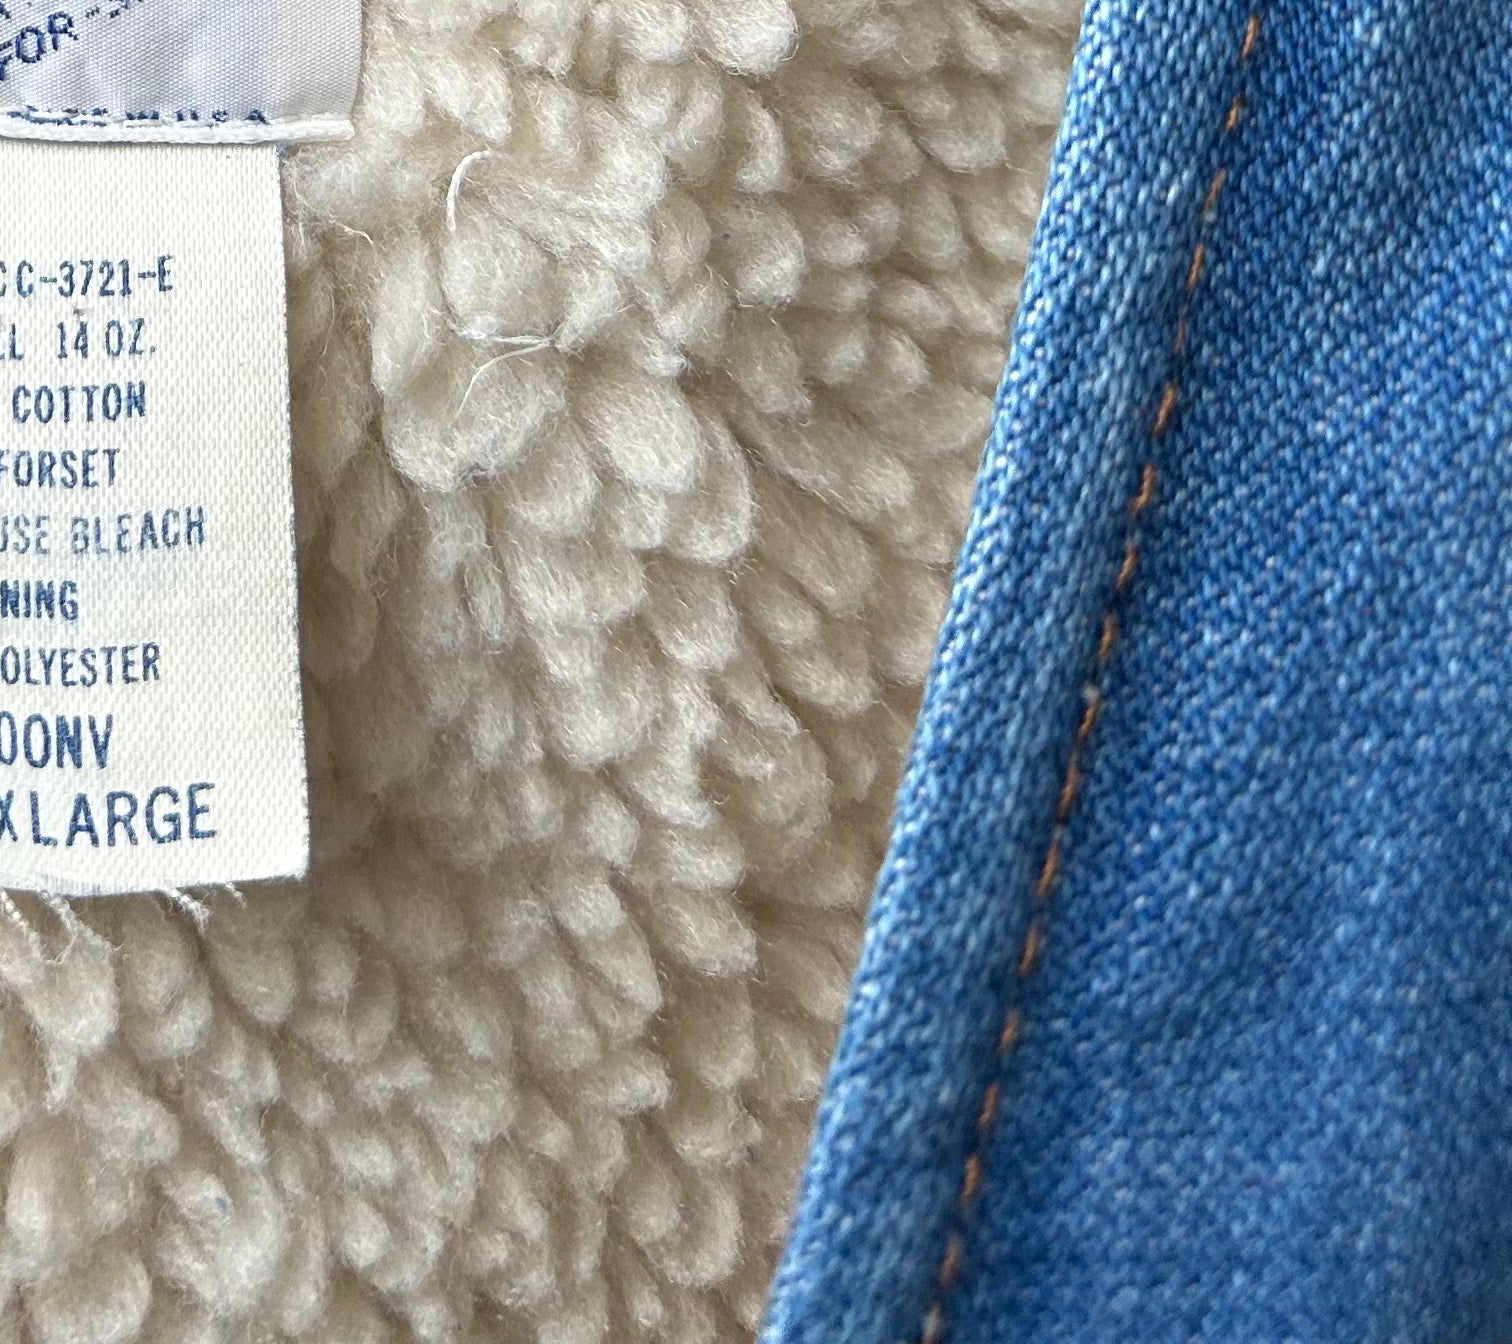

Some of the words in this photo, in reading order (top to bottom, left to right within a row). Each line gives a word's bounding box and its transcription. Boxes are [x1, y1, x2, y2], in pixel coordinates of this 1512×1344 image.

[56, 322, 88, 359] 14
[104, 317, 157, 357] OZ.
[11, 381, 147, 424] COTTON
[71, 506, 207, 555] BLEACH
